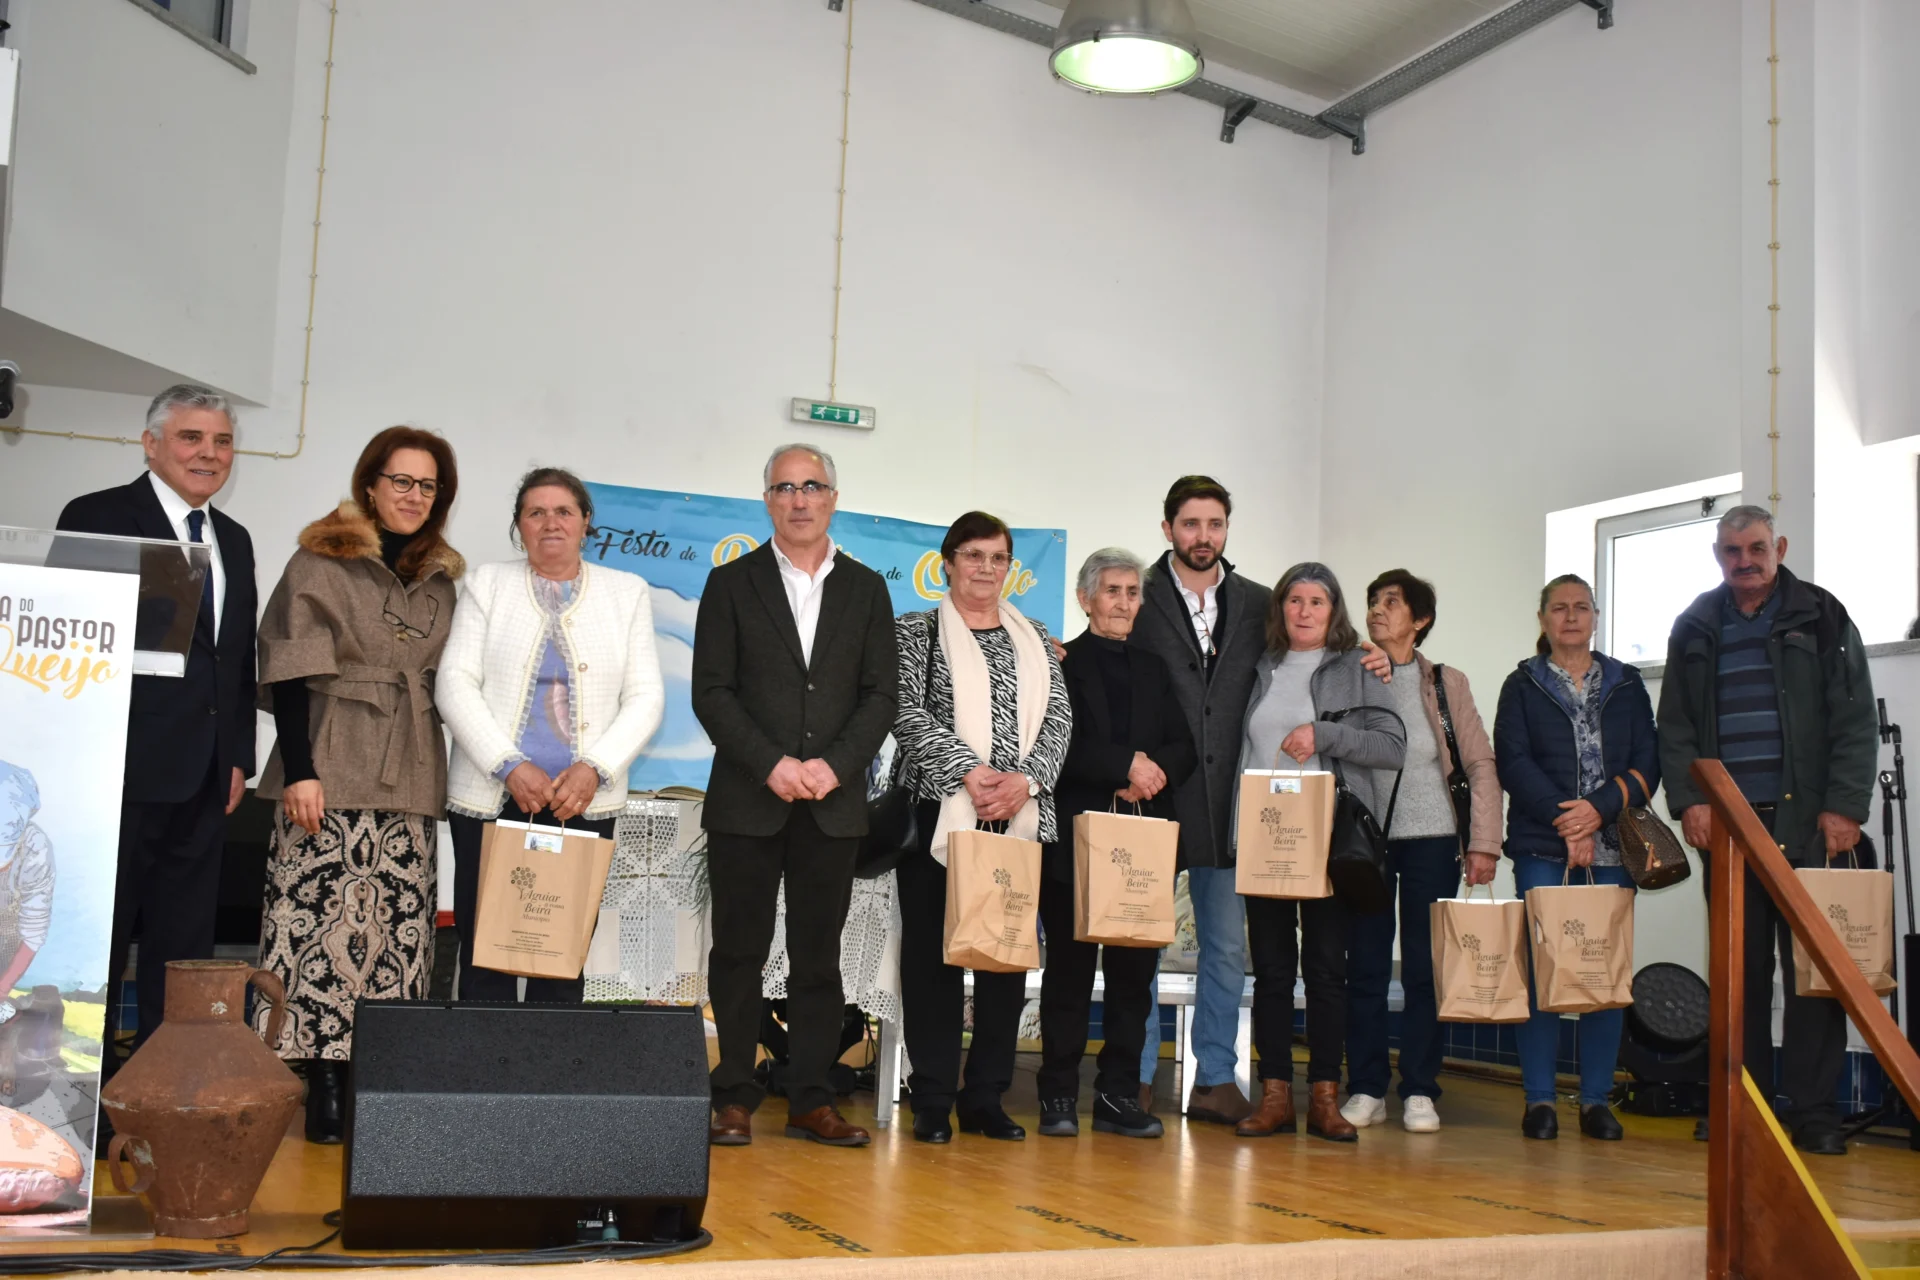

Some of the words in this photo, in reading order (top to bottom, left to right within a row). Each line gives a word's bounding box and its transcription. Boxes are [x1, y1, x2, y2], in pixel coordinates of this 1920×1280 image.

[593, 525, 672, 561] Festa
[679, 545, 698, 561] do
[886, 566, 904, 581] do
[20, 598, 34, 613] DO
[16, 614, 116, 654] PASTOR
[524, 902, 551, 916] Beira
